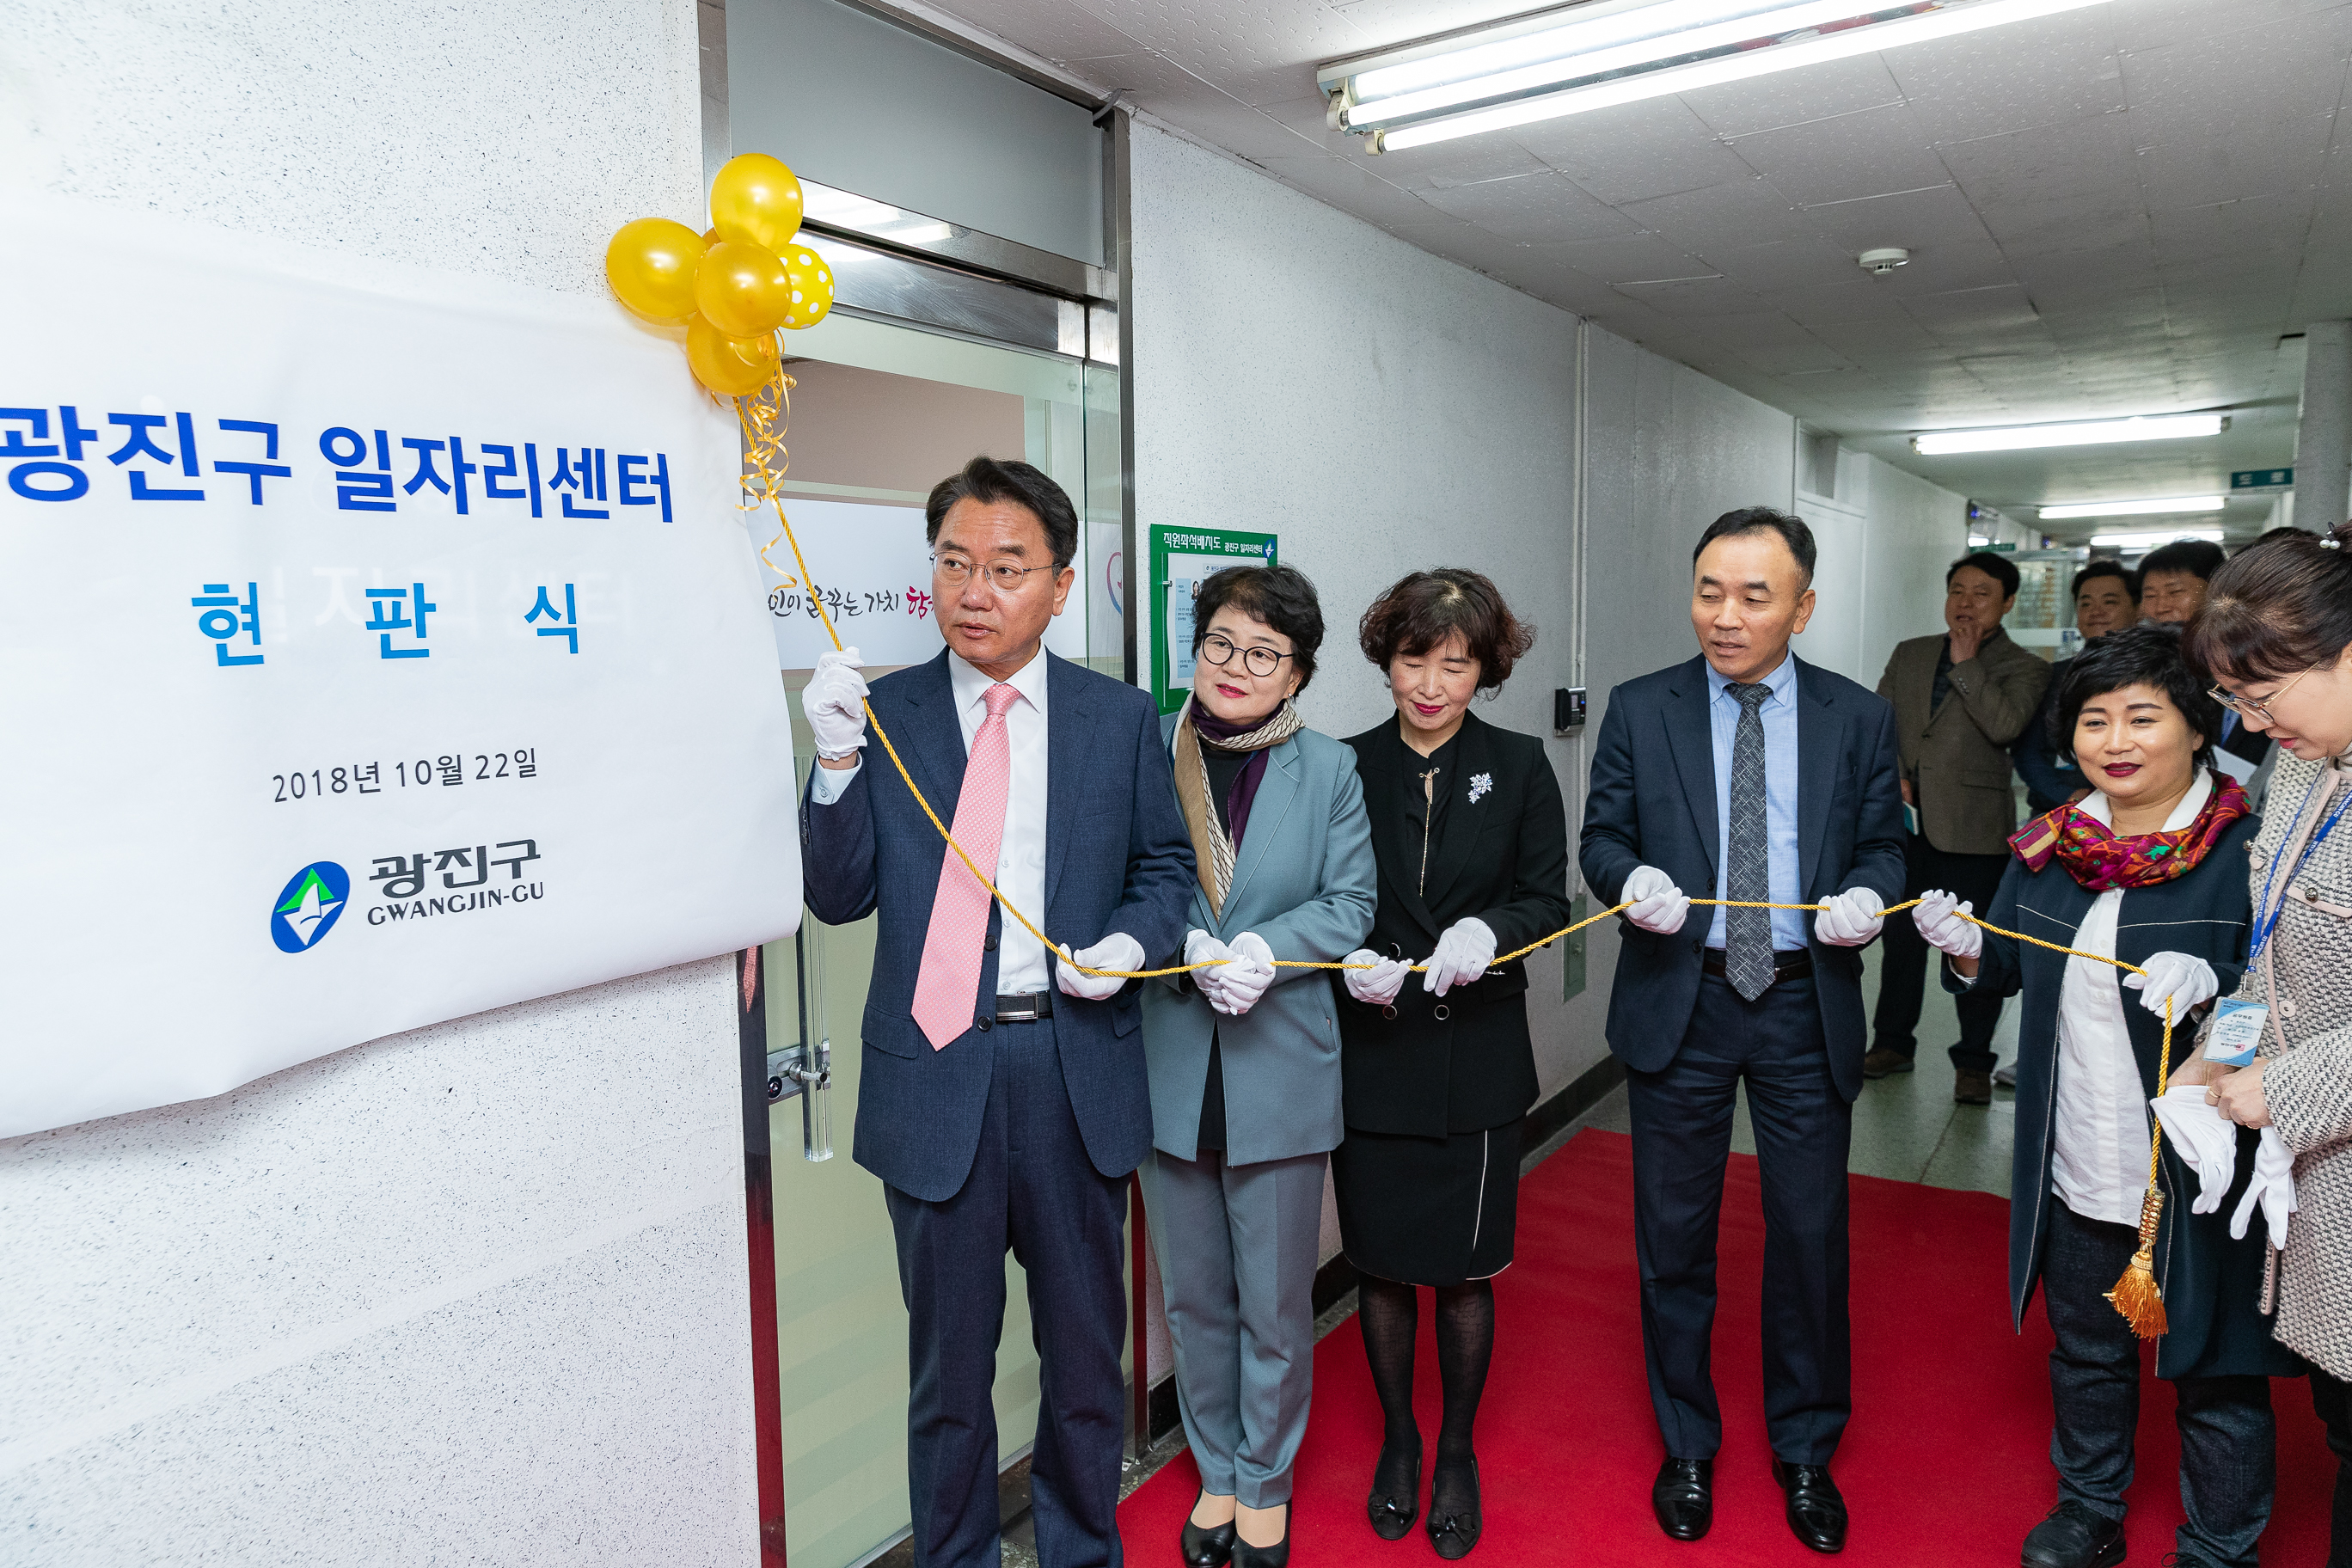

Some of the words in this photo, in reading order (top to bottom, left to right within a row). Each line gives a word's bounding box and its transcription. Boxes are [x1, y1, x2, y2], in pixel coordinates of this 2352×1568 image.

[0, 405, 292, 506] 광진구
[319, 426, 673, 524] 일자리센터
[1163, 532, 1221, 550] 직원좌석배치도
[1224, 542, 1240, 553] 광진구
[1240, 543, 1263, 554] 일자리센터
[865, 589, 899, 613] 가치
[273, 761, 382, 803] 2018년
[395, 754, 464, 787] 10월
[475, 747, 537, 781] 22일
[369, 838, 542, 899] 광진구
[367, 881, 544, 927] GWANGJIN-GU
